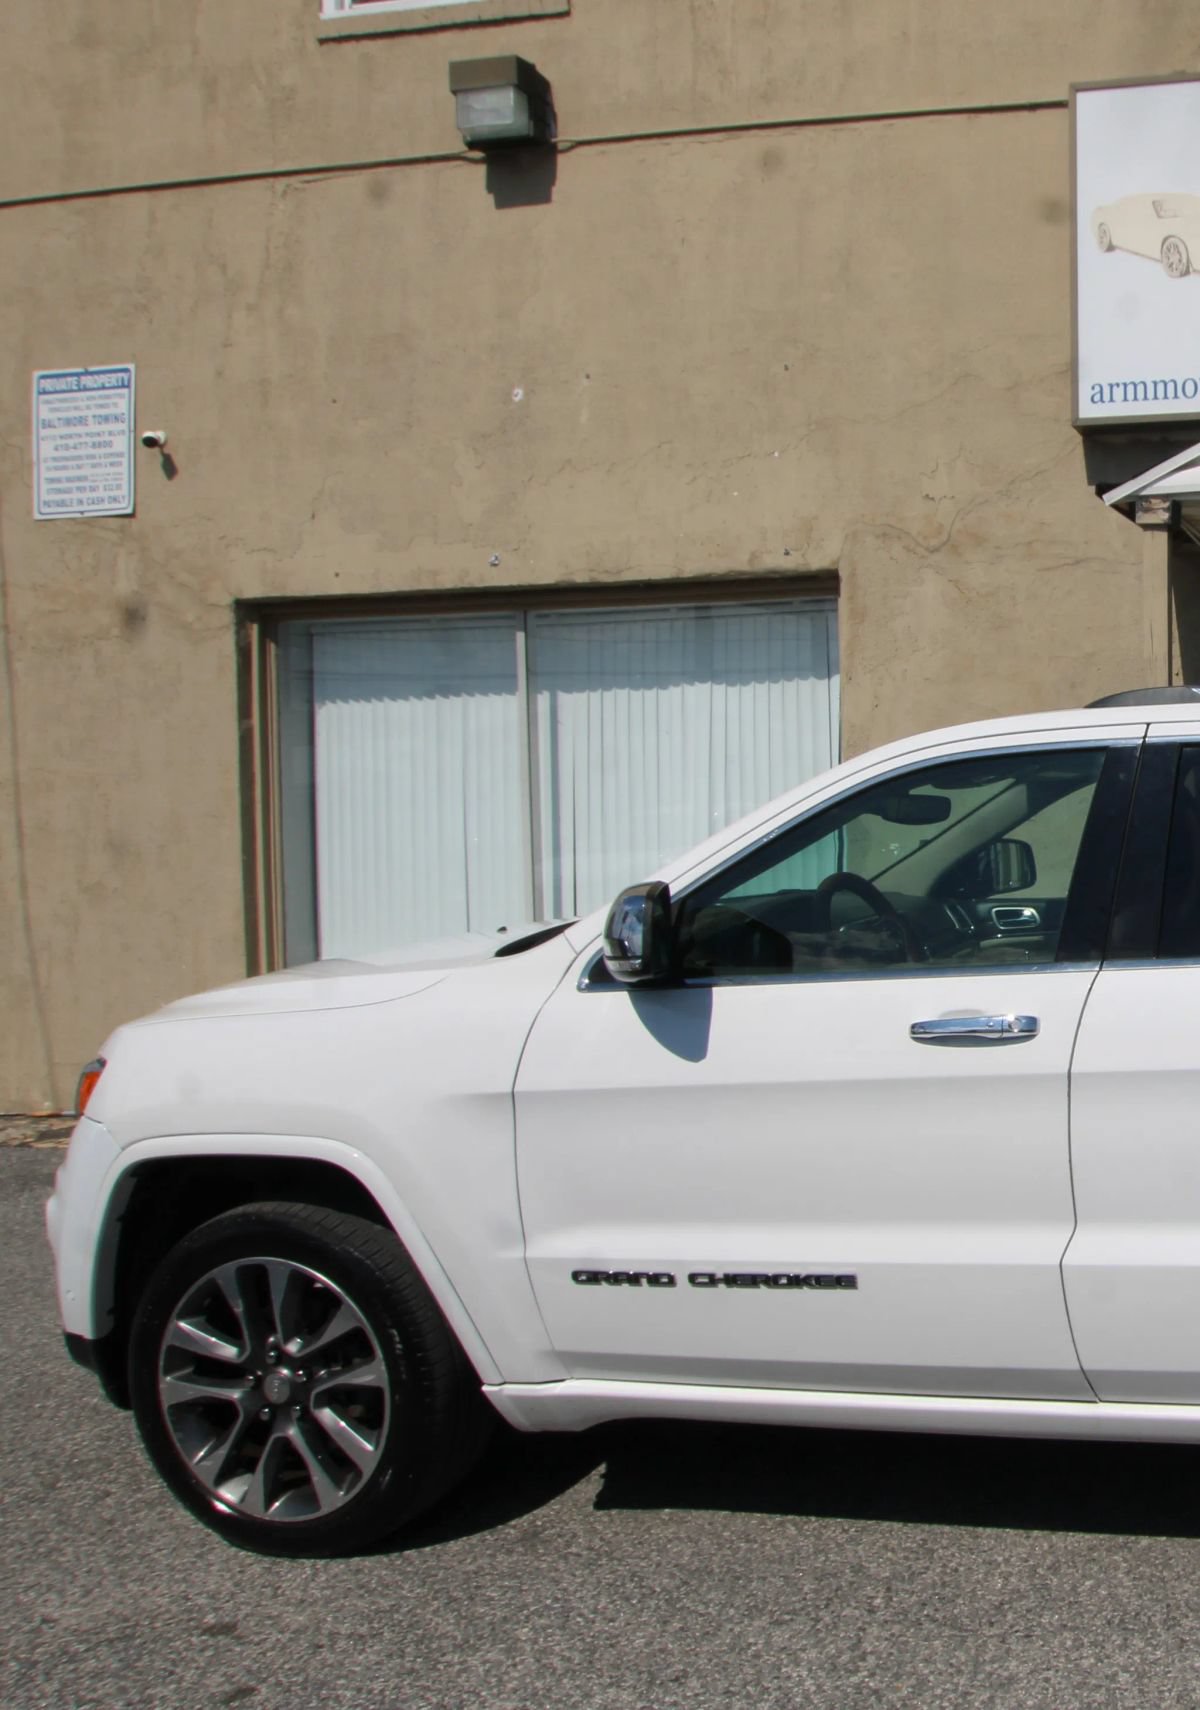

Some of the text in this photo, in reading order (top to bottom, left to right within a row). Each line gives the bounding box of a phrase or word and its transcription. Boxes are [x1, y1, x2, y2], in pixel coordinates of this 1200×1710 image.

[80, 372, 130, 390] PROPERTY
[41, 412, 126, 430] BALTIMORE TOWING
[571, 1269, 859, 1290] GRAND CHEROKEE
